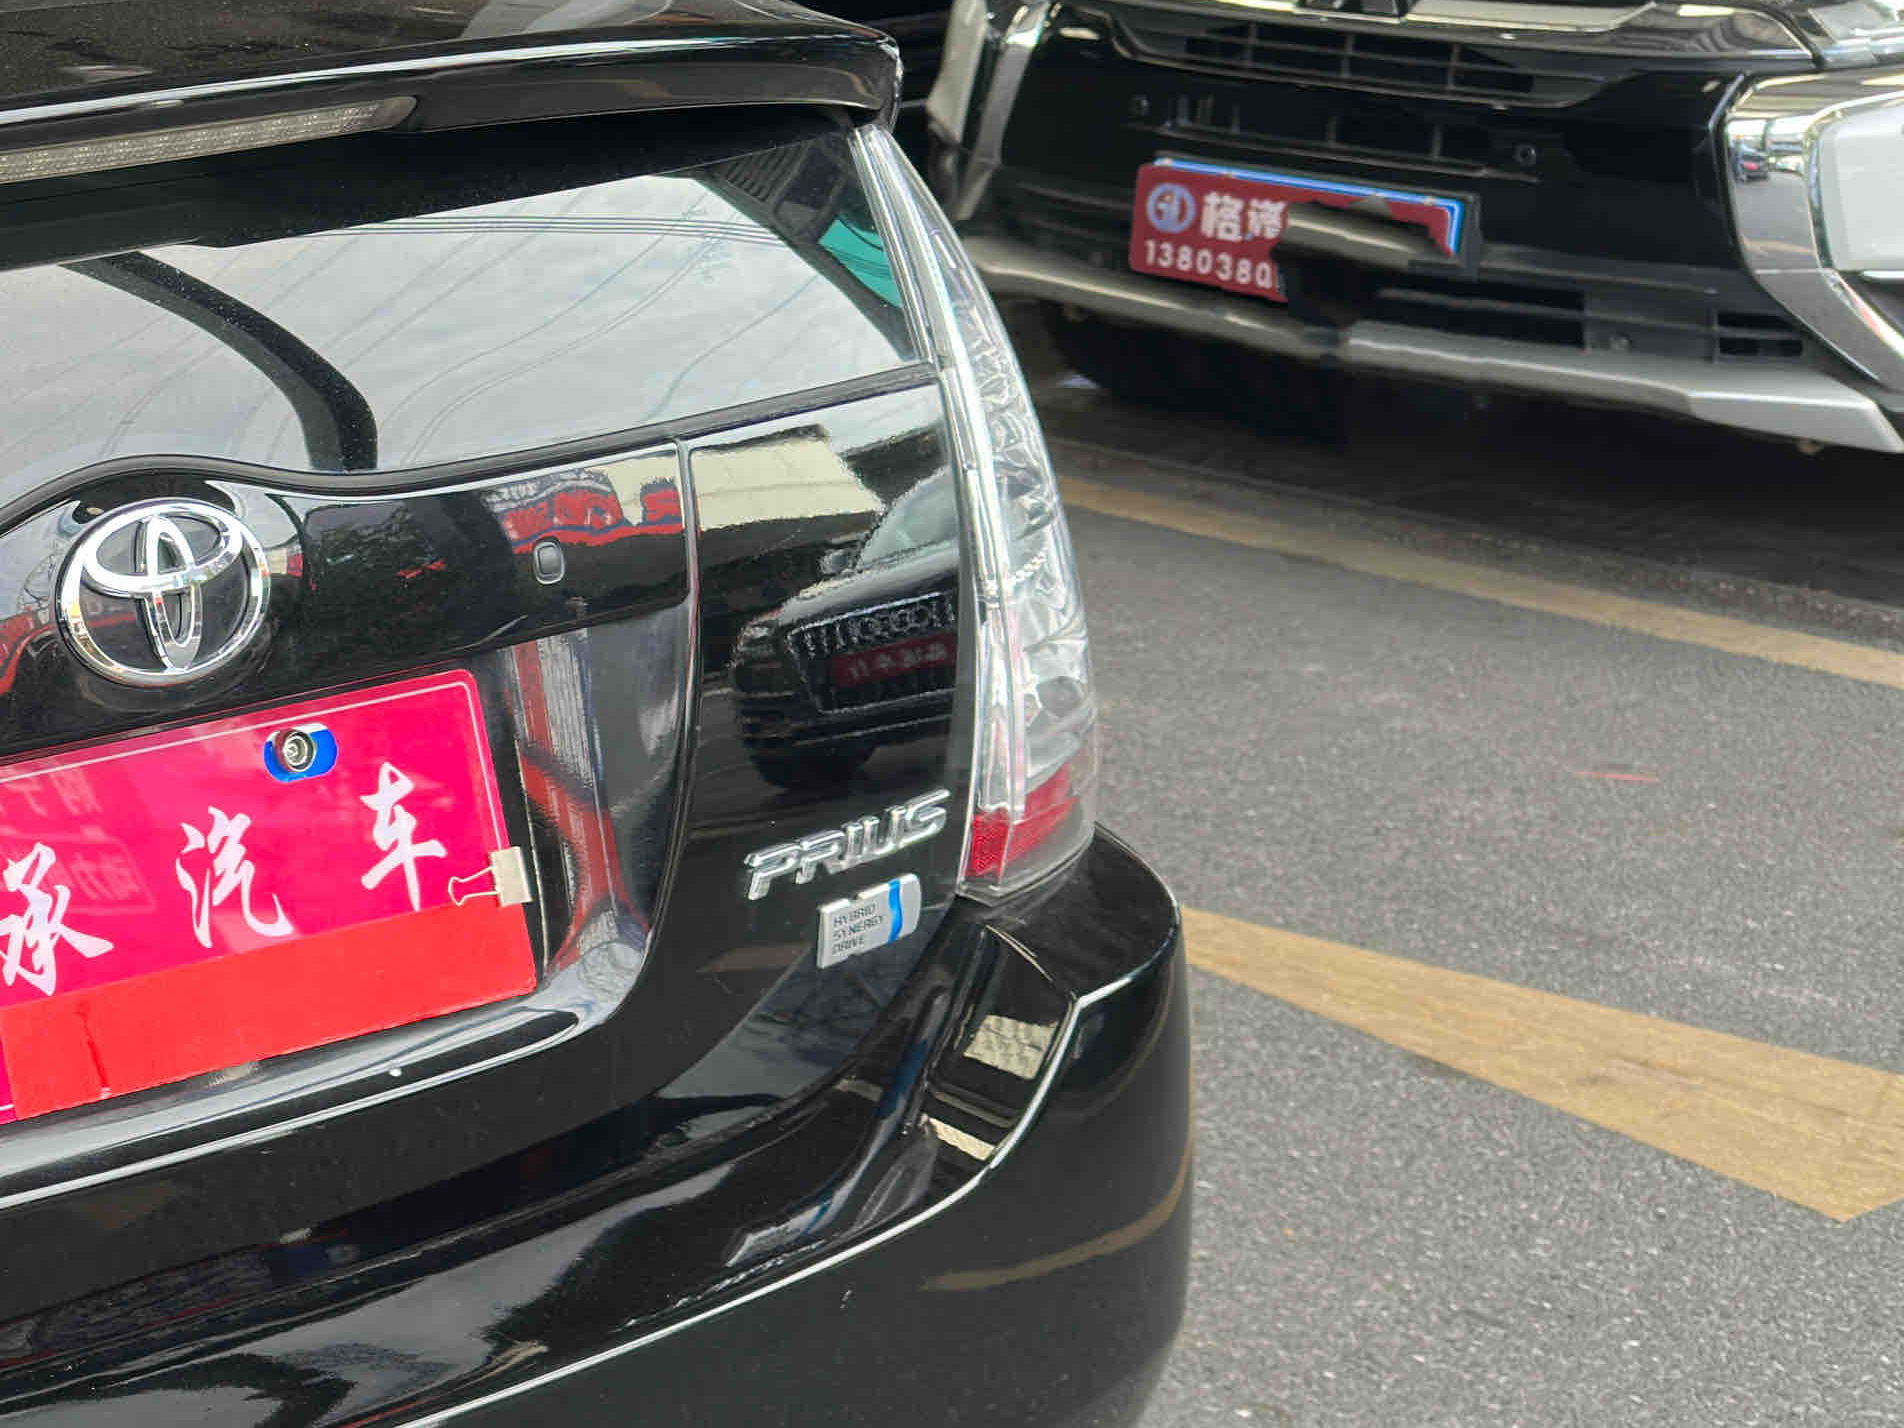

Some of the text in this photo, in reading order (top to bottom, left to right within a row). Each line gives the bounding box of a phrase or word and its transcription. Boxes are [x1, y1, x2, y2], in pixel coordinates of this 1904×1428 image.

[744, 788, 950, 900] PRIUS
[833, 903, 878, 926] HYBRID
[833, 915, 883, 941] SYNERGY
[832, 936, 865, 954] DRIVE
